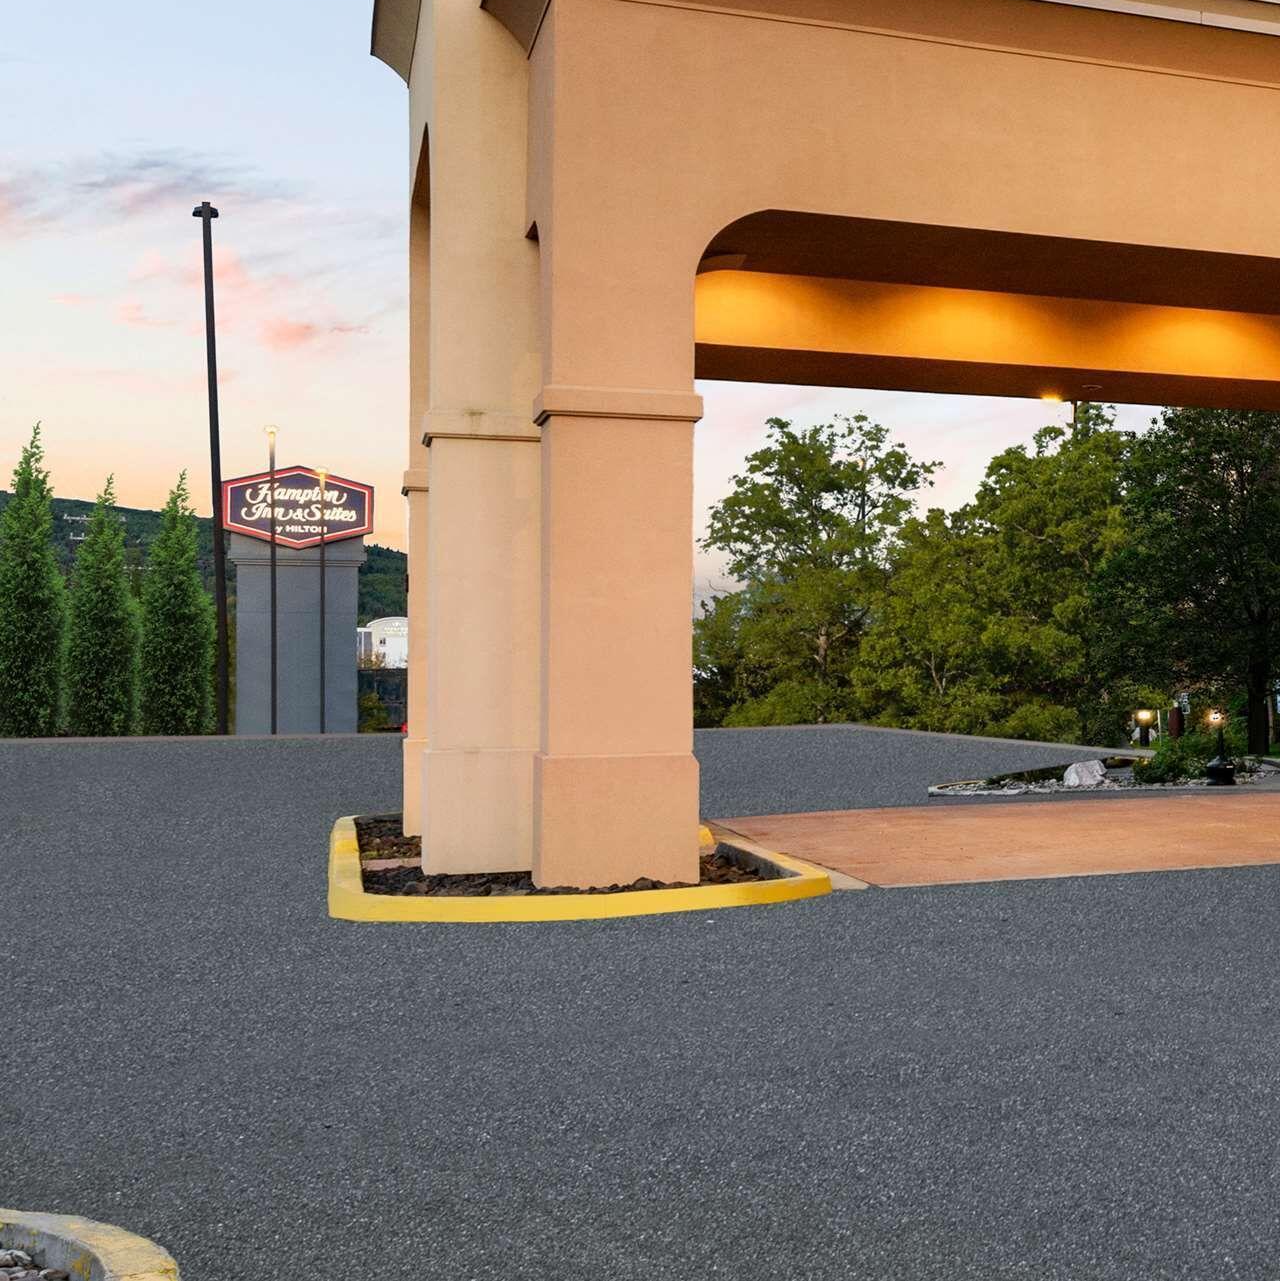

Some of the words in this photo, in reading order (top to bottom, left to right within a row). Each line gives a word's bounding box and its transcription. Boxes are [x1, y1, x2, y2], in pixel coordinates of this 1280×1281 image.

[240, 502, 293, 521] Inn
[292, 507, 306, 521] &
[285, 524, 328, 534] HILTON
